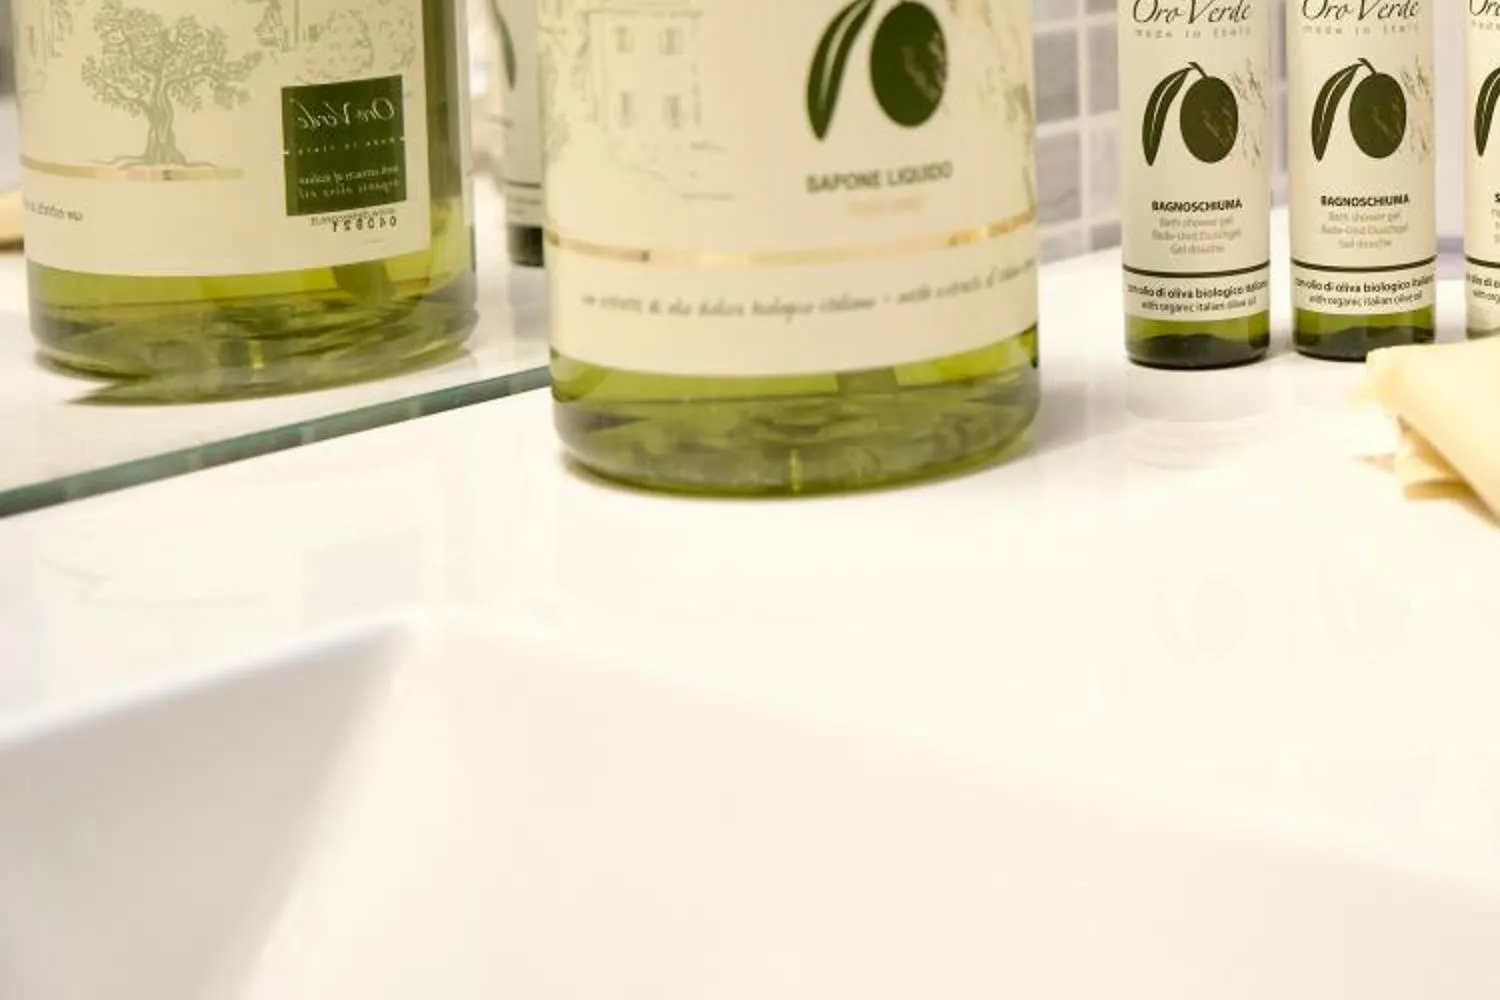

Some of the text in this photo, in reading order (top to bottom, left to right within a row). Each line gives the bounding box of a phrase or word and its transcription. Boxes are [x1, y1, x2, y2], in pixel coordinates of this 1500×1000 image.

[805, 159, 954, 194] SAPONE LIQUIDO
[1151, 199, 1243, 212] BAGNOSCHIUMA
[1321, 193, 1409, 207] BAGNOSCHIUMA
[1167, 287, 1193, 299] oliva
[1195, 285, 1244, 300] biologico
[1335, 280, 1361, 293] oliva
[1363, 280, 1410, 294] biologico
[1196, 301, 1225, 313] italian
[1363, 295, 1393, 307] italian
